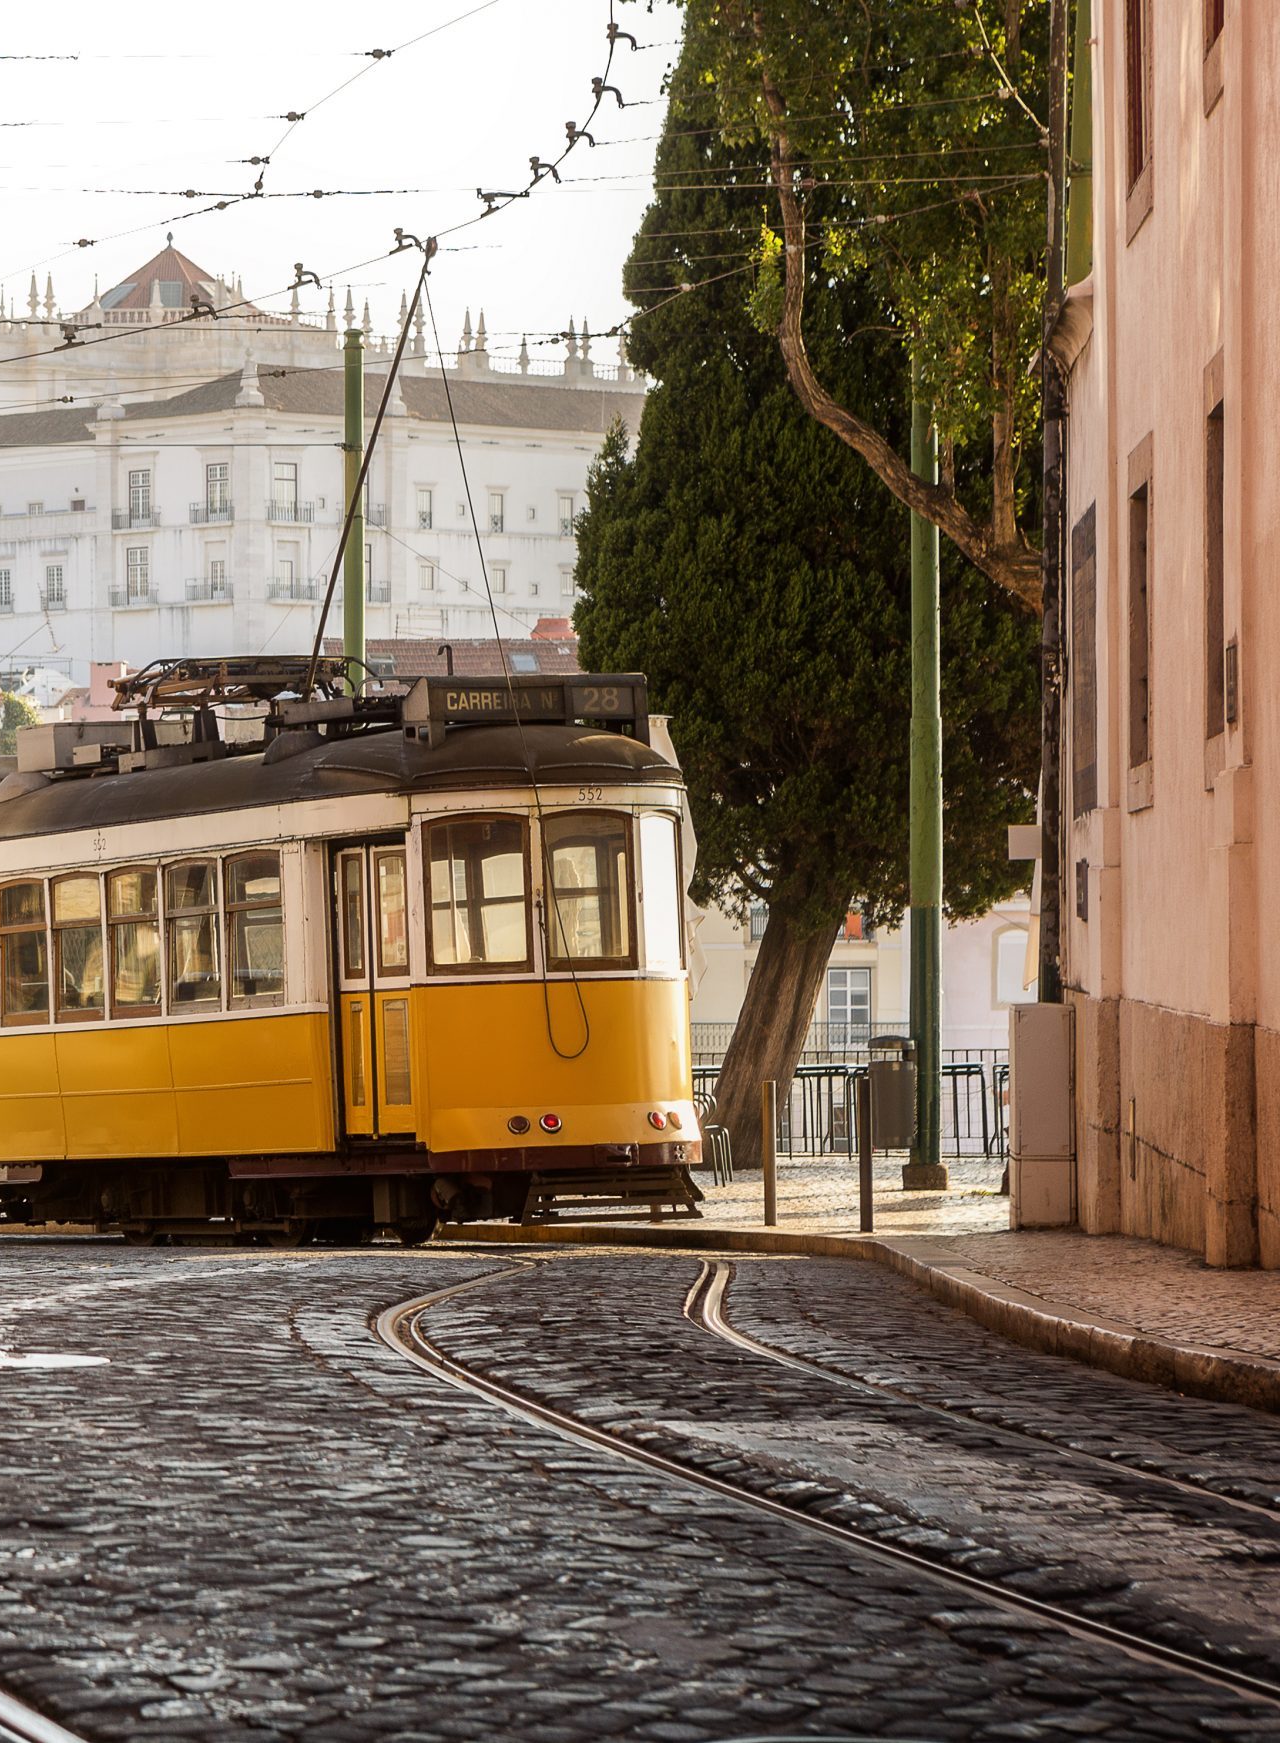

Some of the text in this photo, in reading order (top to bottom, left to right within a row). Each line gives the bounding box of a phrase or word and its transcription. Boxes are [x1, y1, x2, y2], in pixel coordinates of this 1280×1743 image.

[447, 692, 531, 710] CARREIRA
[583, 687, 619, 712] 28
[577, 787, 603, 802] 552
[93, 838, 107, 851] 552
